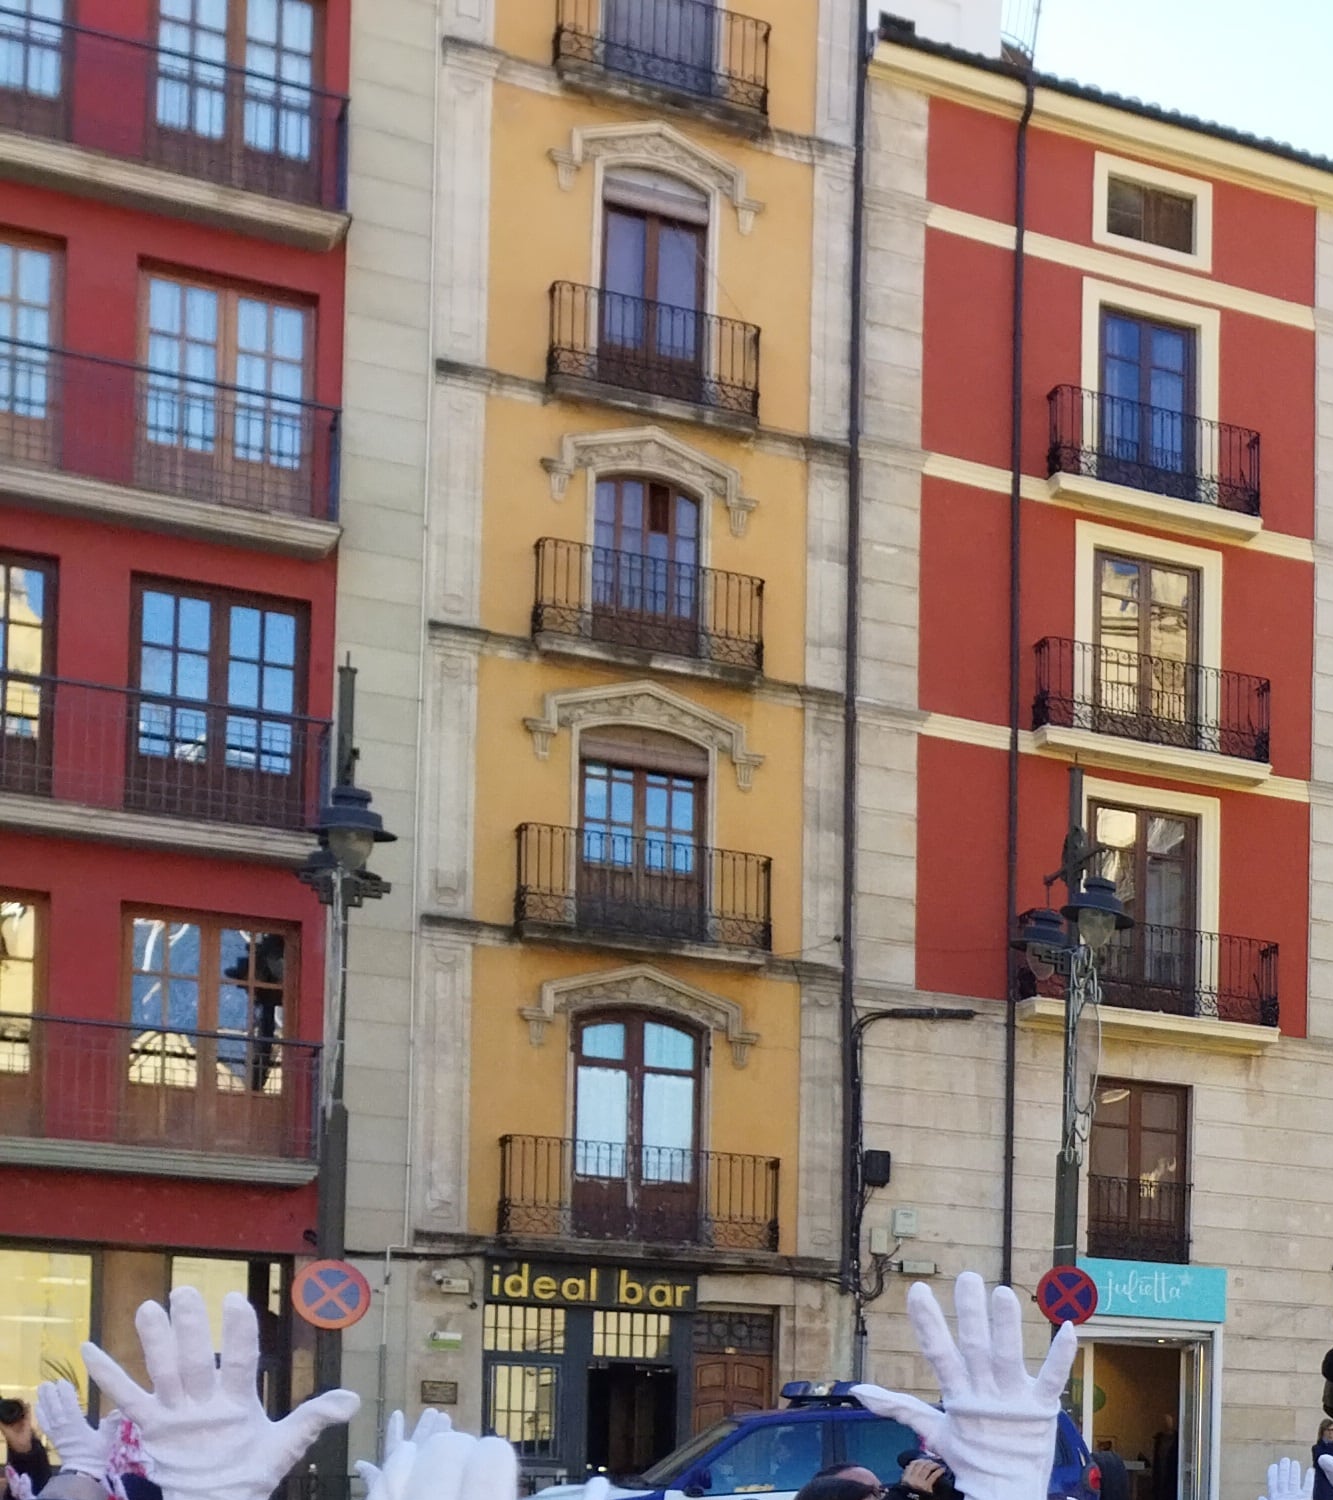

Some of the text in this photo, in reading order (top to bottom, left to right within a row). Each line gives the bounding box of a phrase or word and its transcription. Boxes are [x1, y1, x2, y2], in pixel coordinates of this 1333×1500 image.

[492, 1263, 690, 1307] ideal bar
[1100, 1270, 1181, 1311] julietta
